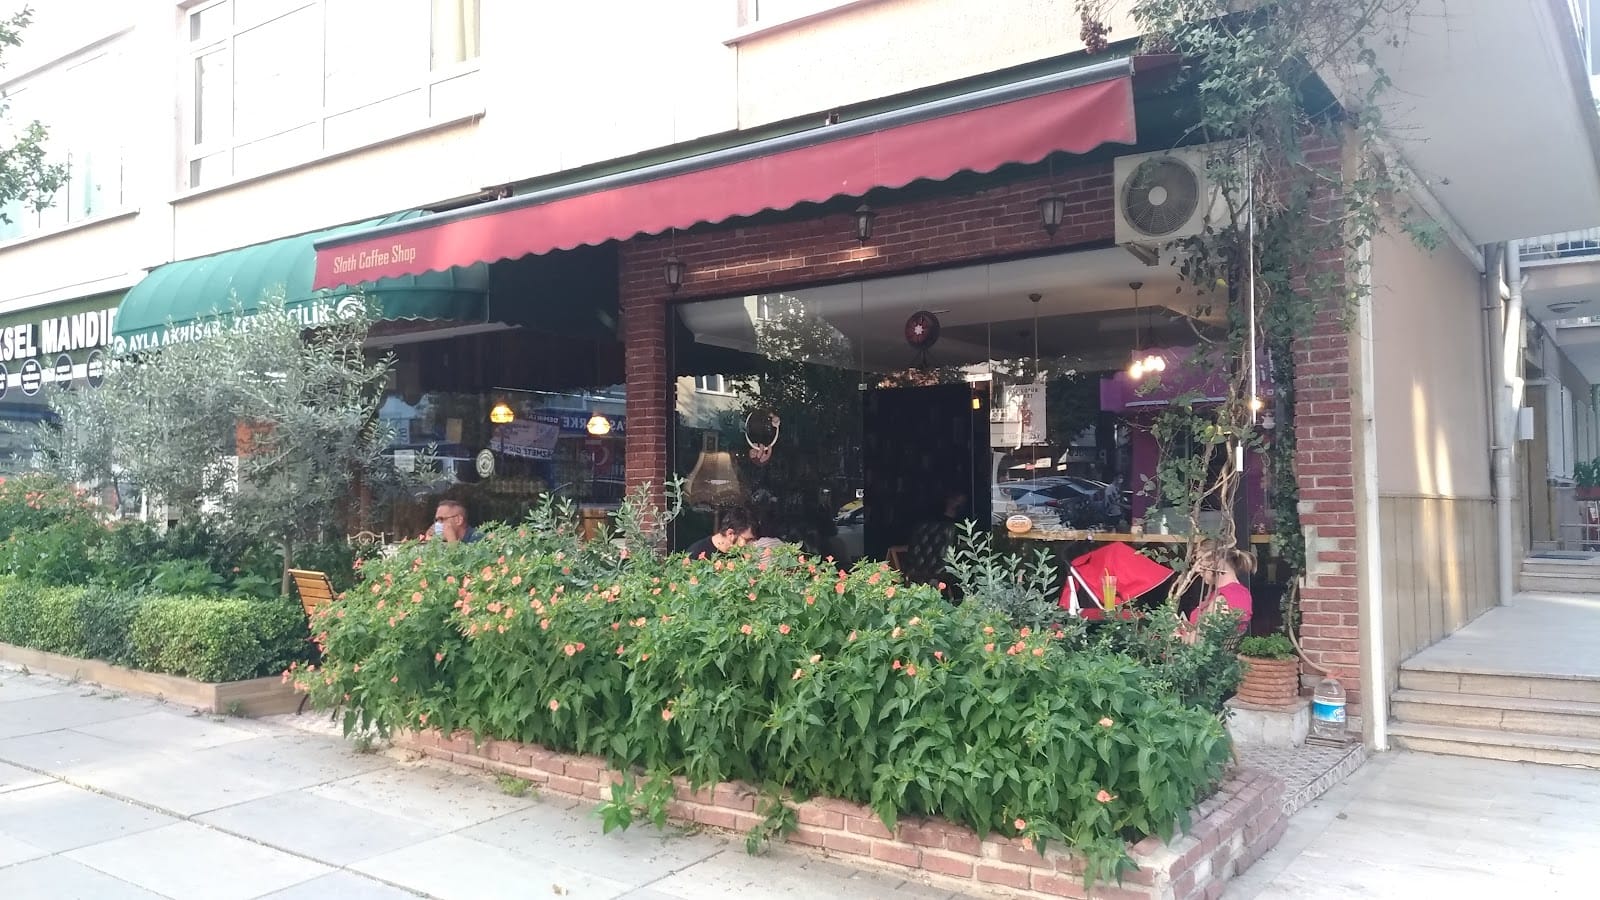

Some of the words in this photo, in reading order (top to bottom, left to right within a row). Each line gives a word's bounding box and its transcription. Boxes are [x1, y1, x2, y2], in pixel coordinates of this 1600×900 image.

[333, 254, 357, 274] Sloth
[359, 248, 390, 270] Coffee
[391, 243, 416, 265] Shop
[129, 331, 160, 352] AYLA
